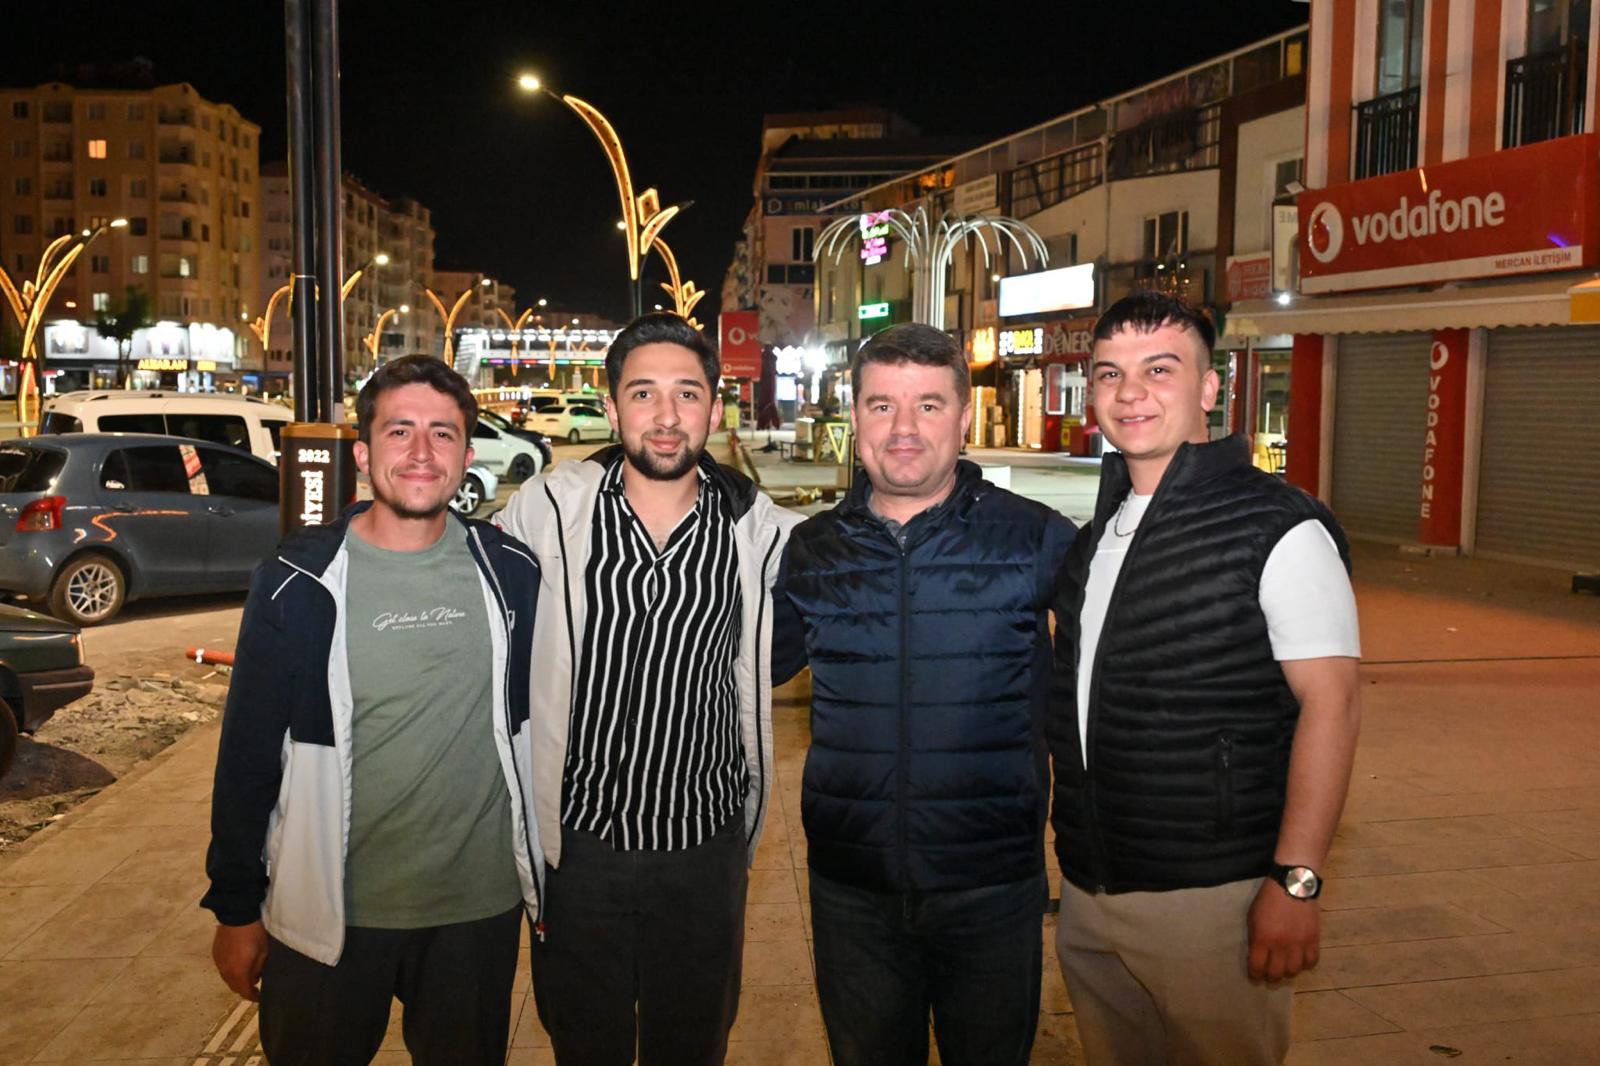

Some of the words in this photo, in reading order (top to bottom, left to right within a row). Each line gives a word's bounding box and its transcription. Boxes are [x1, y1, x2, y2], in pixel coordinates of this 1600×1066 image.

[1352, 189, 1506, 245] vodafone
[1495, 255, 1532, 269] MERCAN
[298, 448, 330, 463] 2022
[1420, 376, 1441, 518] VODAFONE
